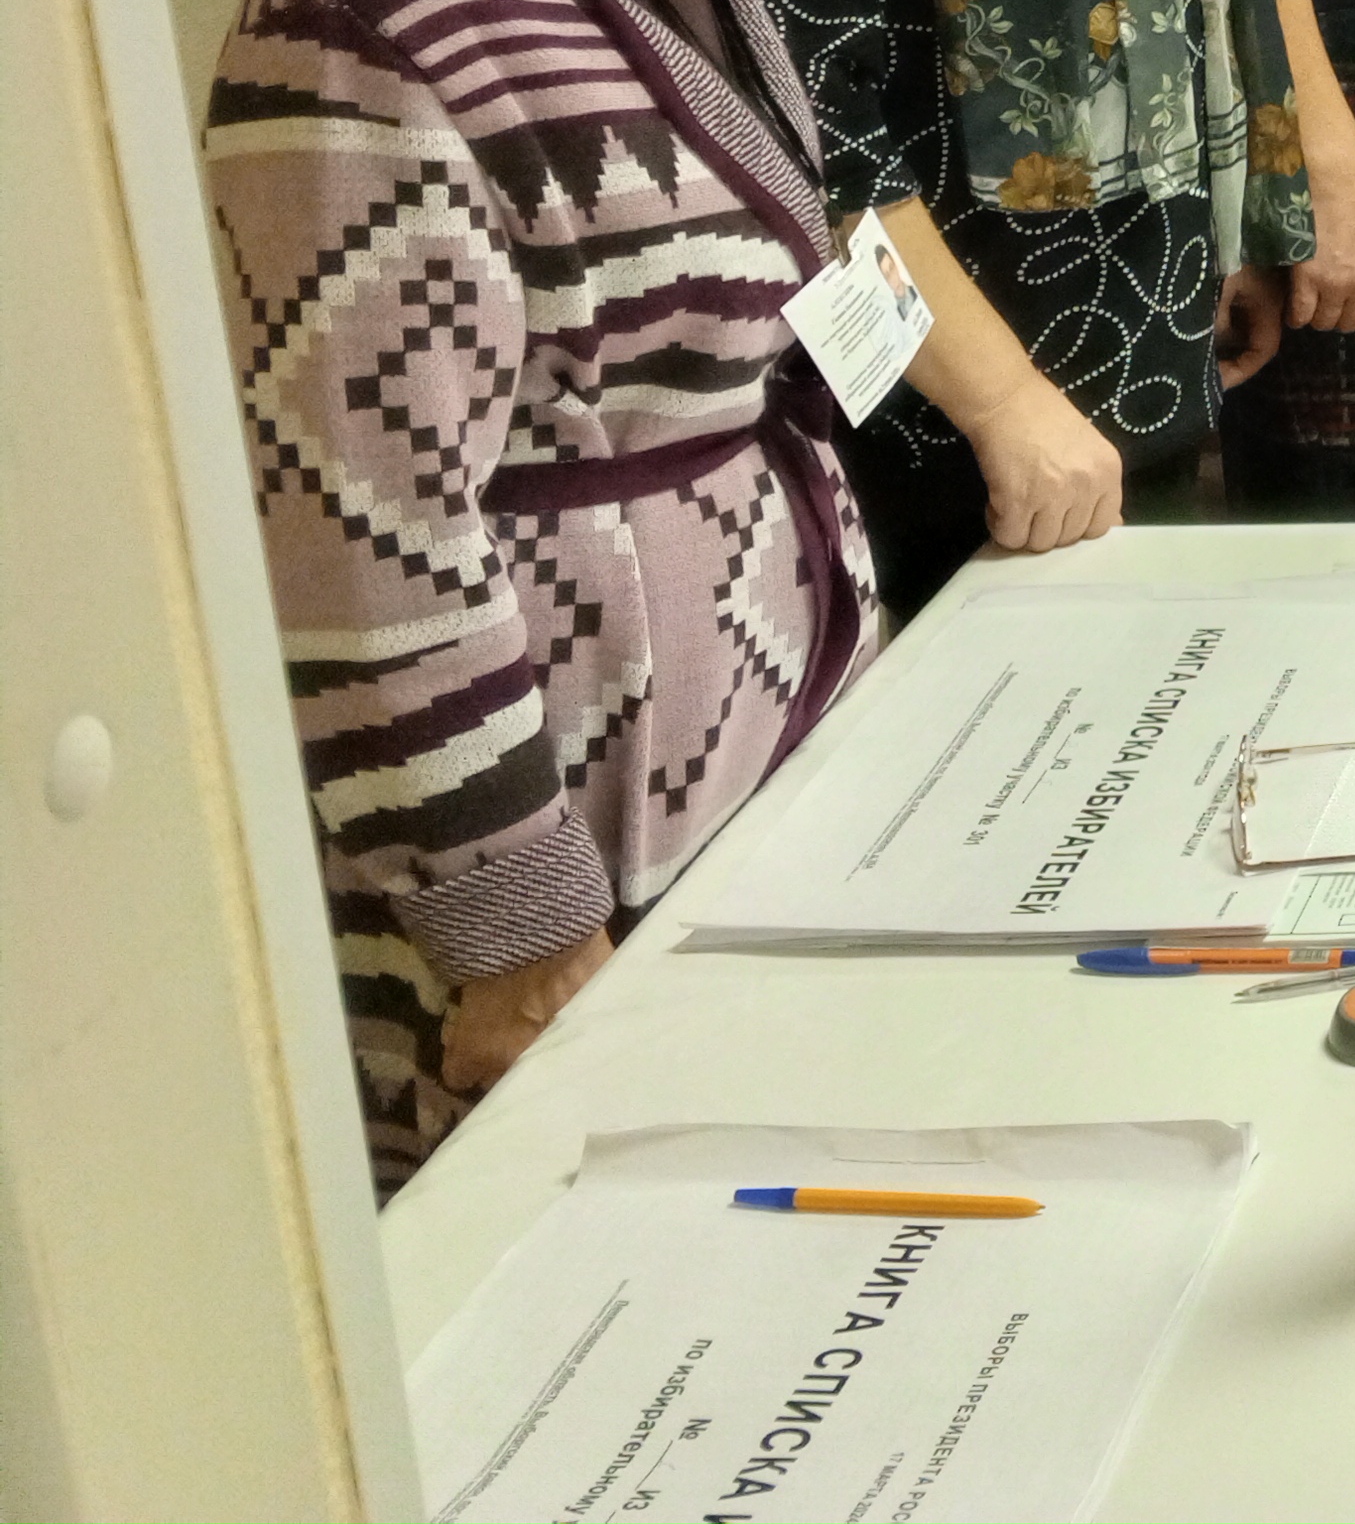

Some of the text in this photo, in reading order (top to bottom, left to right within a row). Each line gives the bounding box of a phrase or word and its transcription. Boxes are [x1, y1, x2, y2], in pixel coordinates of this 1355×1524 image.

[1064, 686, 1082, 698] по
[1011, 698, 1074, 773] избирательному
[1073, 722, 1095, 735] №
[1009, 627, 1227, 915] КНИГА СПИСКА ИЗБИРАТЕЛЕЙ
[1050, 757, 1073, 770] ИЗ
[984, 773, 1025, 810] участку
[977, 813, 1001, 826] №
[962, 829, 989, 846] 301
[685, 1338, 713, 1361] по
[718, 1224, 946, 1501] КНИГА СПИСКА
[679, 1418, 713, 1441] №
[891, 1312, 1030, 1524] ВЫБОРЫ ПРЕЗИДЕНТА РОС
[564, 1364, 695, 1516] избирательному
[889, 1452, 904, 1463] 17
[862, 1465, 898, 1500] МАРТА
[622, 1489, 661, 1511] ИЗ
